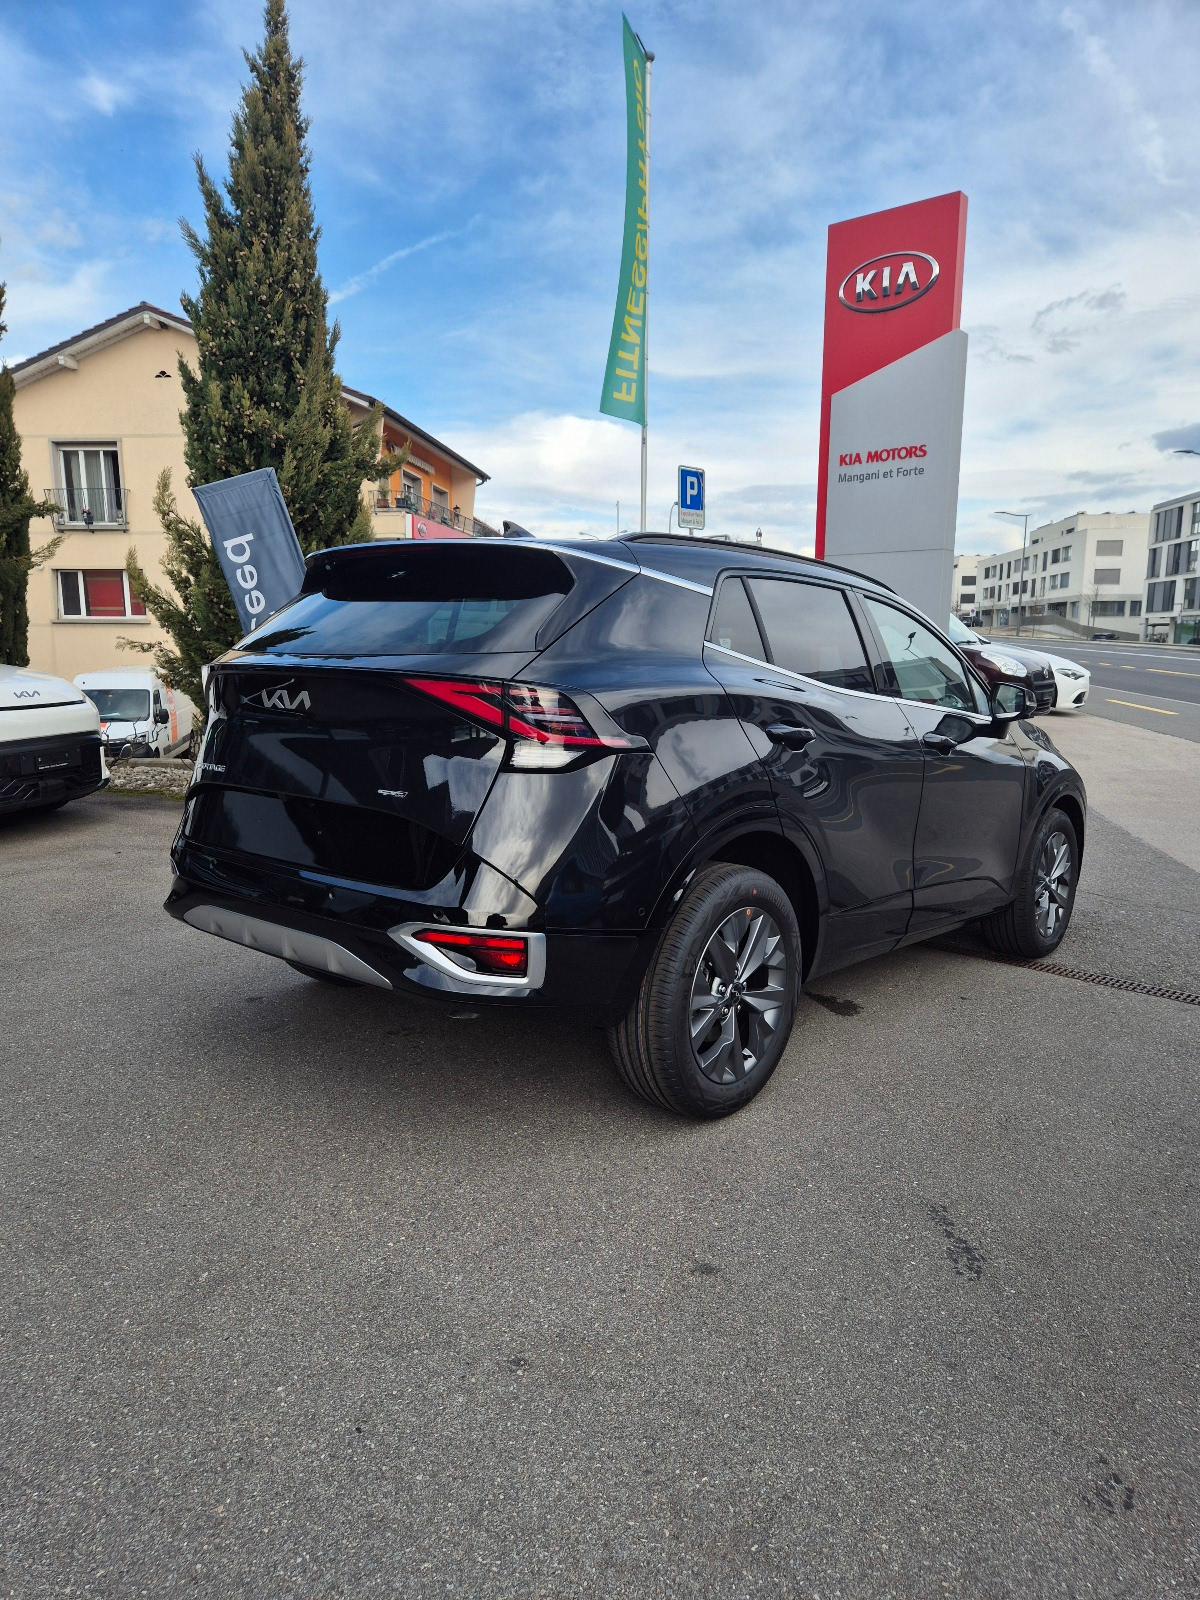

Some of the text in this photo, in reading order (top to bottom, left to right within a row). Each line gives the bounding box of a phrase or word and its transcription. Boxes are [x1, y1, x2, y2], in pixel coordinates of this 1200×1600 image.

[855, 261, 920, 303] KIA
[839, 444, 928, 467] KIA MOTORS
[838, 466, 925, 484] Mangani et Forte
[686, 475, 699, 505] P
[13, 690, 41, 699] KIA
[261, 688, 312, 711] KIA
